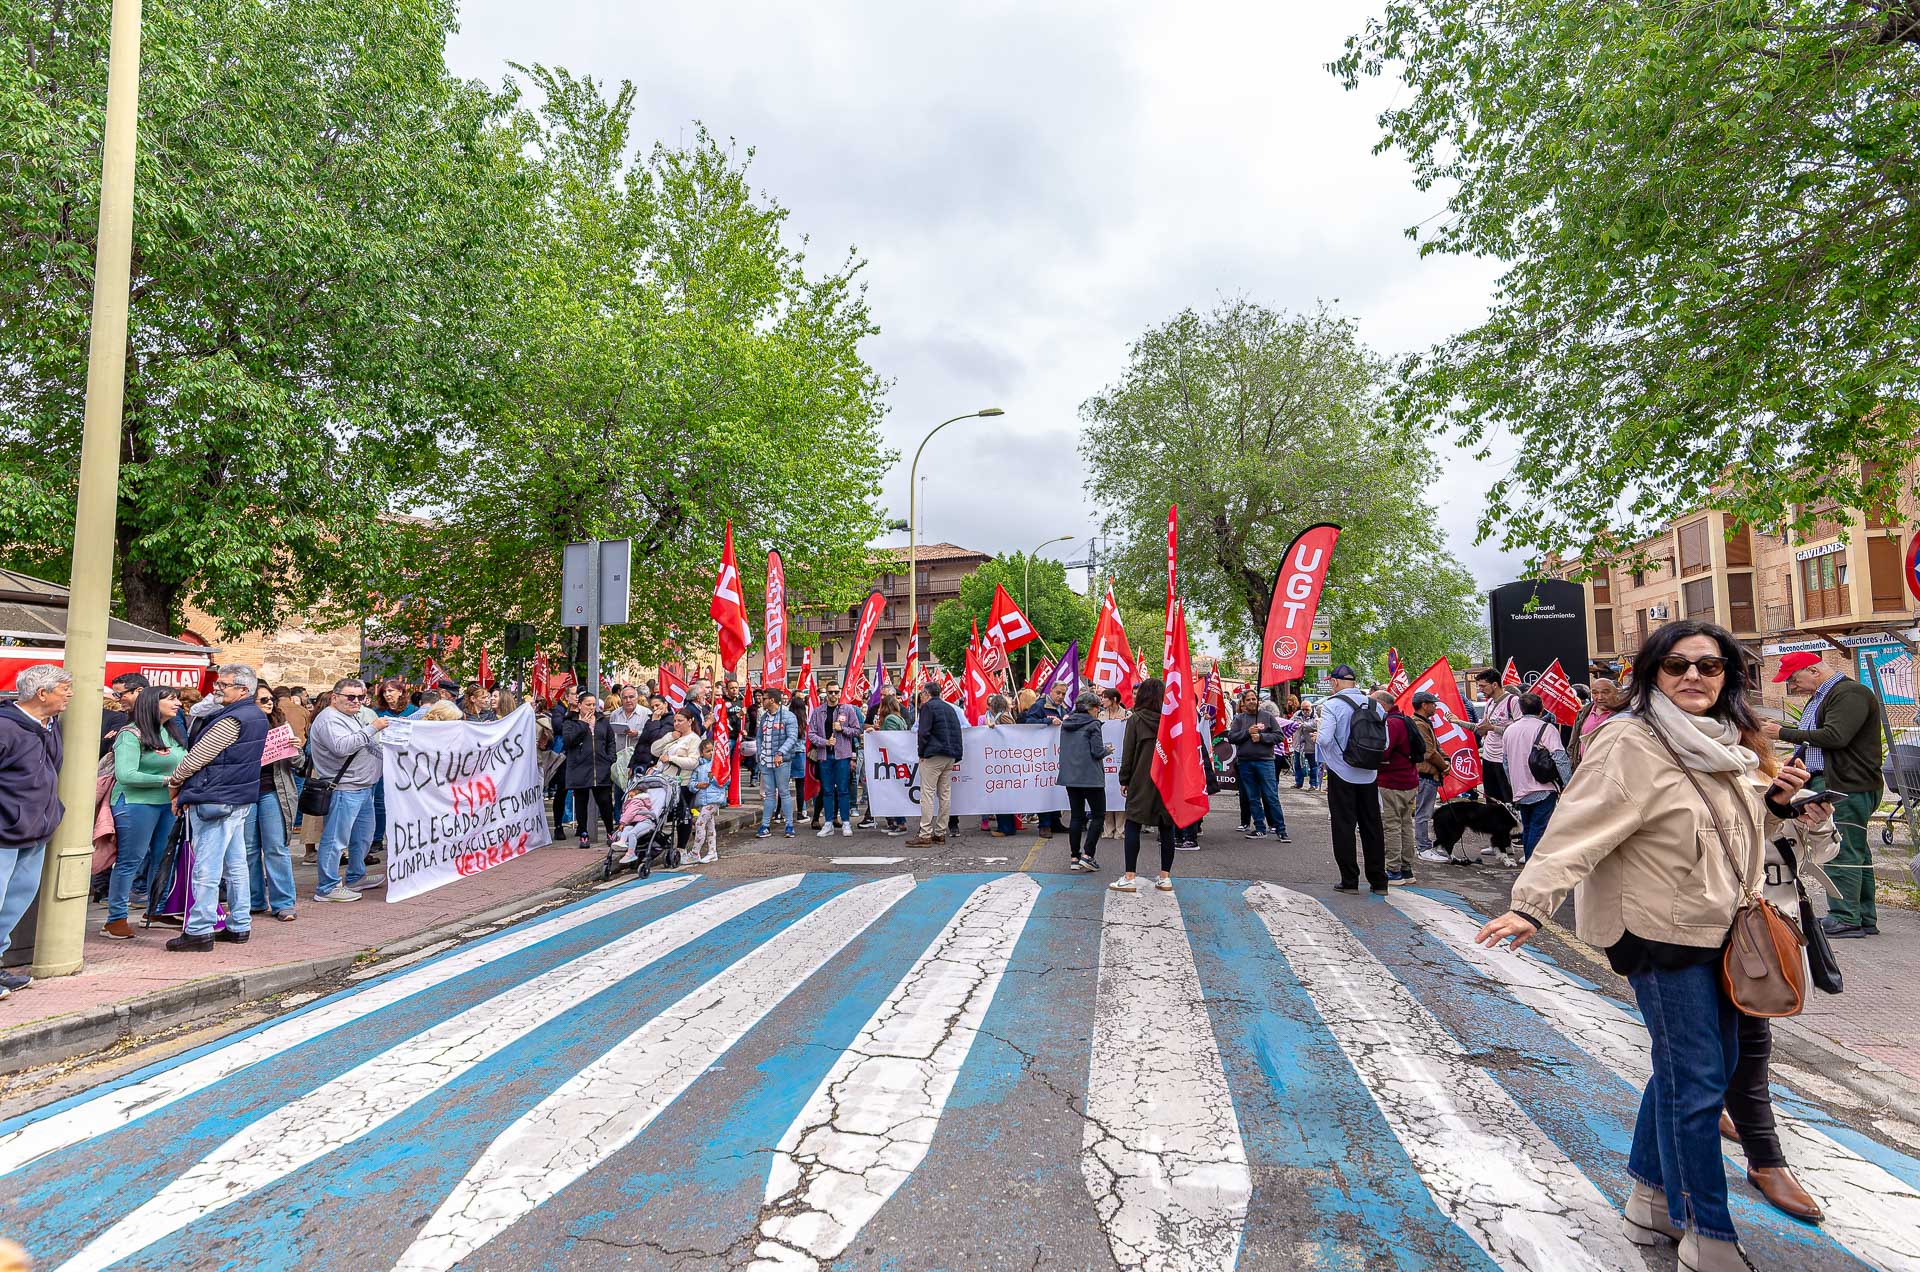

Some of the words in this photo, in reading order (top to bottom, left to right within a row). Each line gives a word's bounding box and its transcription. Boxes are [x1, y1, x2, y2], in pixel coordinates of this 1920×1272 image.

[1797, 541, 1845, 561] GAVILANES
[1283, 543, 1323, 629] UGT
[1533, 612, 1576, 620] Renacimiento
[1778, 641, 1826, 653] Reconocimiento
[1840, 636, 1879, 646] onductores
[1272, 663, 1292, 671] Toledo
[985, 746, 1048, 762] Proteger
[985, 779, 1029, 794] ganar
[1216, 775, 1236, 783] LEDO
[394, 812, 480, 857] DELEGADO
[388, 849, 438, 883] CUMPLA
[442, 840, 463, 863] LOS
[523, 814, 544, 834] CON
